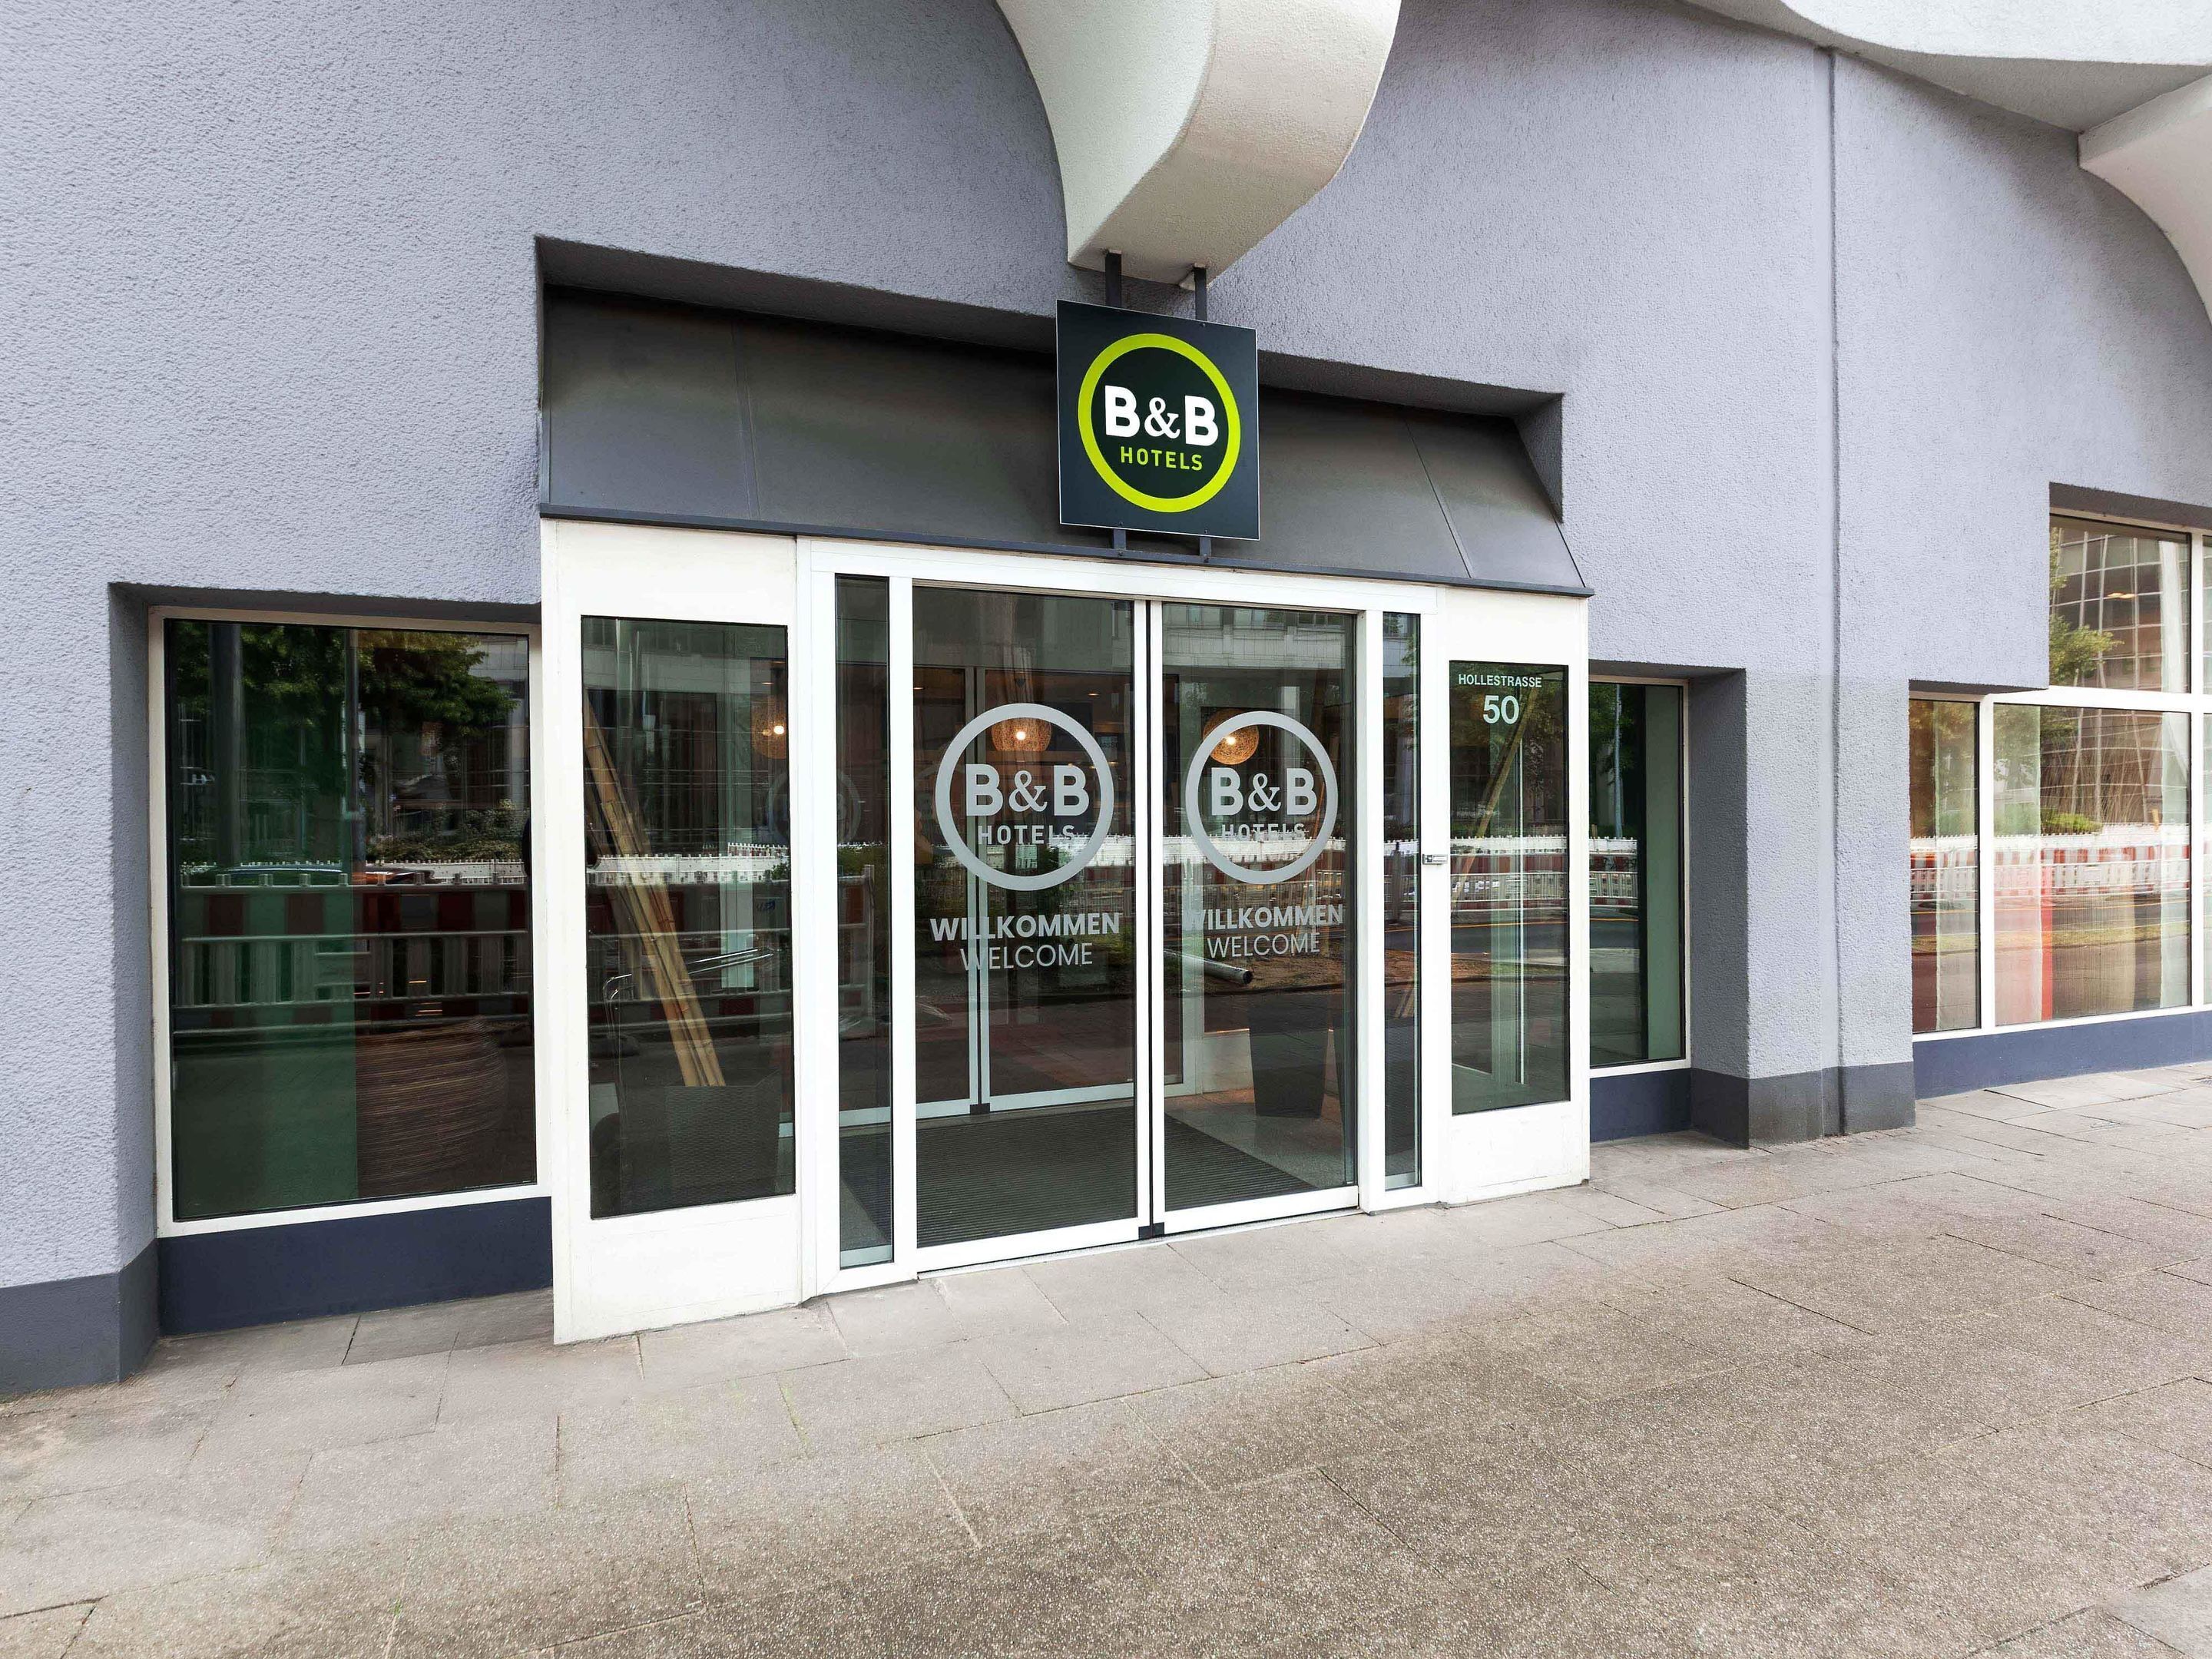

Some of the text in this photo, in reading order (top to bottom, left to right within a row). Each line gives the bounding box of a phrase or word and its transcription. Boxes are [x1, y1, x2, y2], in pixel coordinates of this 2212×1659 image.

[1104, 385, 1219, 446] B&B
[1120, 446, 1203, 471] HOTELS
[1459, 674, 1542, 687] HOLLESTRASSE
[1482, 694, 1520, 724] 50
[965, 763, 1090, 816] B&B
[1210, 767, 1318, 816] B&B
[978, 824, 1075, 845] HOTELS
[1222, 823, 1305, 841] HOTELS
[929, 912, 1120, 942] WILLKOMMEN
[960, 942, 1093, 971] WELCOME
[1207, 932, 1320, 959] WELCOME
